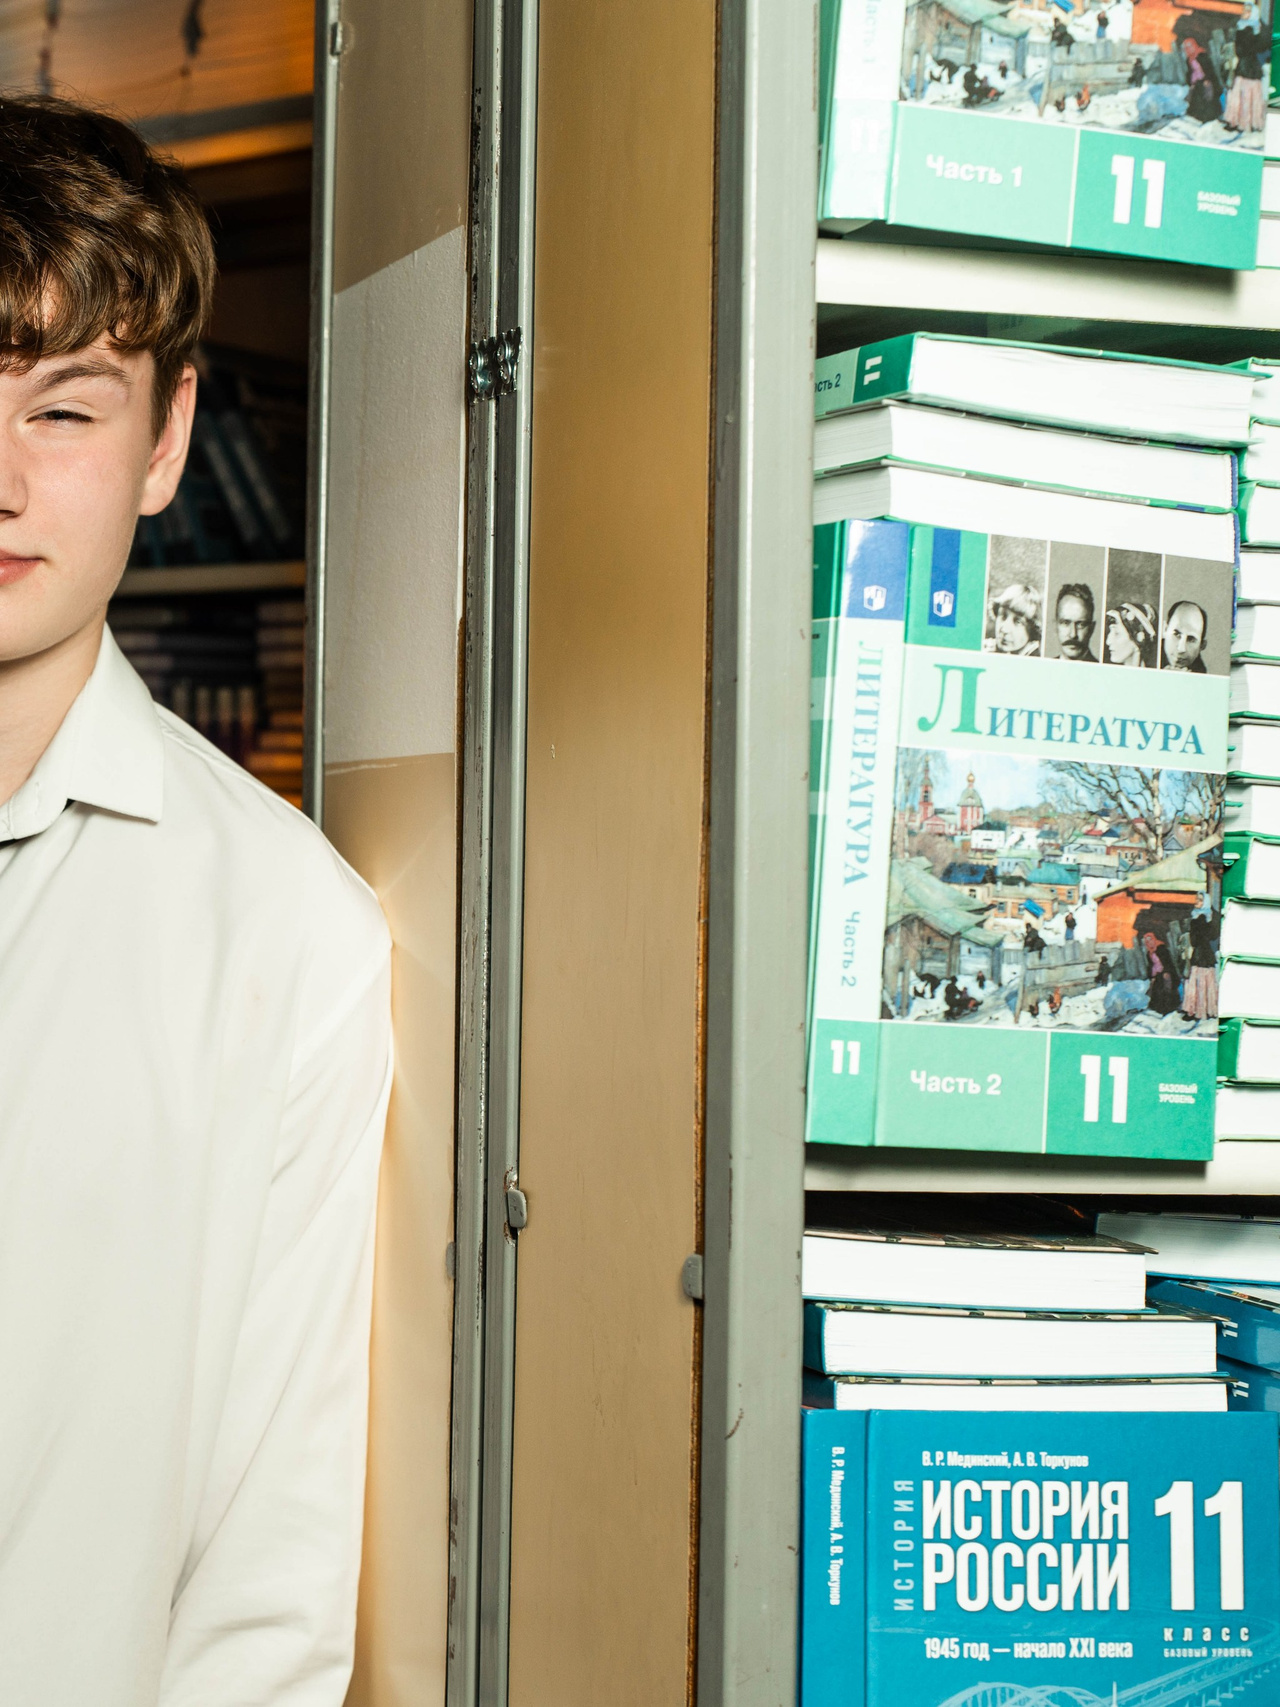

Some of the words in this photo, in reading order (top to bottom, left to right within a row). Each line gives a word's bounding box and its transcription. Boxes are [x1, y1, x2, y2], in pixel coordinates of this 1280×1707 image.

[862, 0, 881, 47] асть
[925, 153, 1004, 186] Часть
[1012, 165, 1023, 188] 1
[1110, 154, 1166, 229] 11
[834, 373, 842, 388] 2
[863, 355, 883, 386] 11
[842, 640, 884, 888] ЛИТЕРАТУРА
[841, 911, 861, 970] Часть
[840, 975, 858, 988] 2
[830, 1039, 861, 1076] 11
[910, 1069, 982, 1095] Часть
[986, 1073, 1002, 1096] 2
[1080, 1054, 1130, 1124] 11
[1158, 1082, 1198, 1094] БАЗОВЫЙ
[1158, 1093, 1196, 1104] УРОВЕНЬ
[831, 1446, 846, 1457] В.
[831, 1459, 846, 1468] Р.
[921, 1450, 934, 1467] В.
[935, 1450, 946, 1467] Р.
[946, 1450, 1012, 1469] Мединский,
[1013, 1451, 1025, 1467] А.
[1026, 1451, 1038, 1467] В.
[1039, 1451, 1090, 1470] Торкунов
[829, 1469, 845, 1532] Мединский,
[922, 1478, 1130, 1541] ИСТОРИЯ
[830, 1532, 844, 1544] А.
[830, 1545, 844, 1557] В.
[892, 1479, 915, 1612] ИСТОРИЯ
[1154, 1480, 1245, 1611] 11
[828, 1558, 844, 1606] Торкунов
[922, 1541, 1131, 1612] РОССИИ
[923, 1637, 961, 1660] 1945
[962, 1642, 991, 1662] год
[1013, 1641, 1067, 1660] начало
[1068, 1636, 1096, 1659] XXI
[1097, 1641, 1135, 1659] века
[1162, 1645, 1209, 1658] БАЗОВЫЙ
[1211, 1647, 1254, 1658] УРОВЕНЬ
